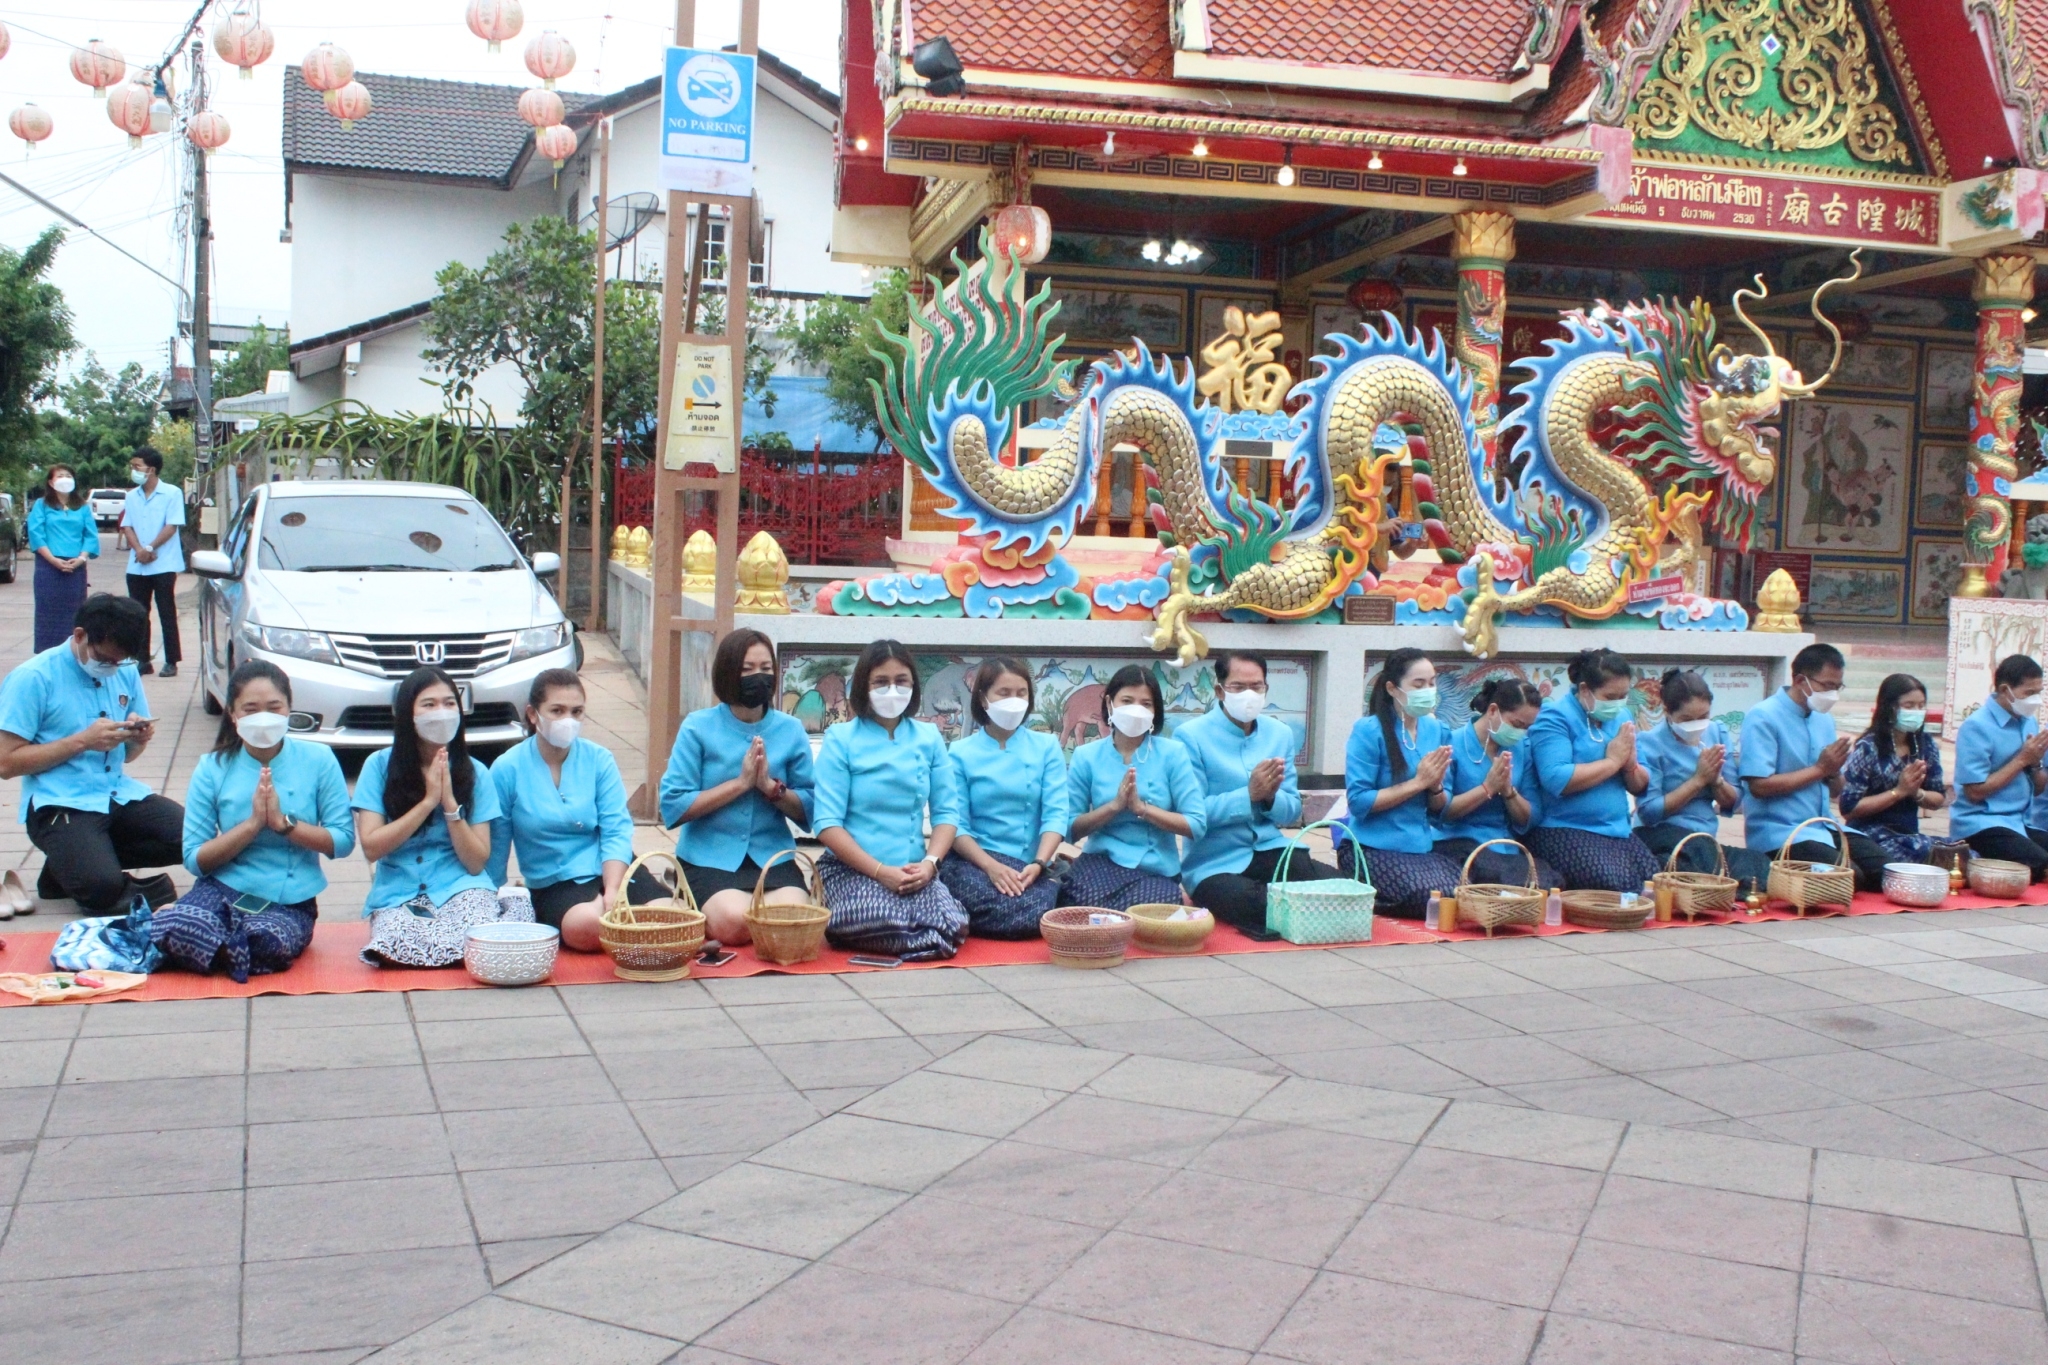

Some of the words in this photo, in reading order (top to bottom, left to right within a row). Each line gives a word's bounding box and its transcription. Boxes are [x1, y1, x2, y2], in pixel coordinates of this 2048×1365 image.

[668, 118, 687, 129] NO
[690, 119, 746, 135] PARKING
[1630, 166, 1763, 208] จ้าพ่อหลักเมือง
[1658, 206, 1665, 217] 5
[1732, 212, 1755, 225] 2530
